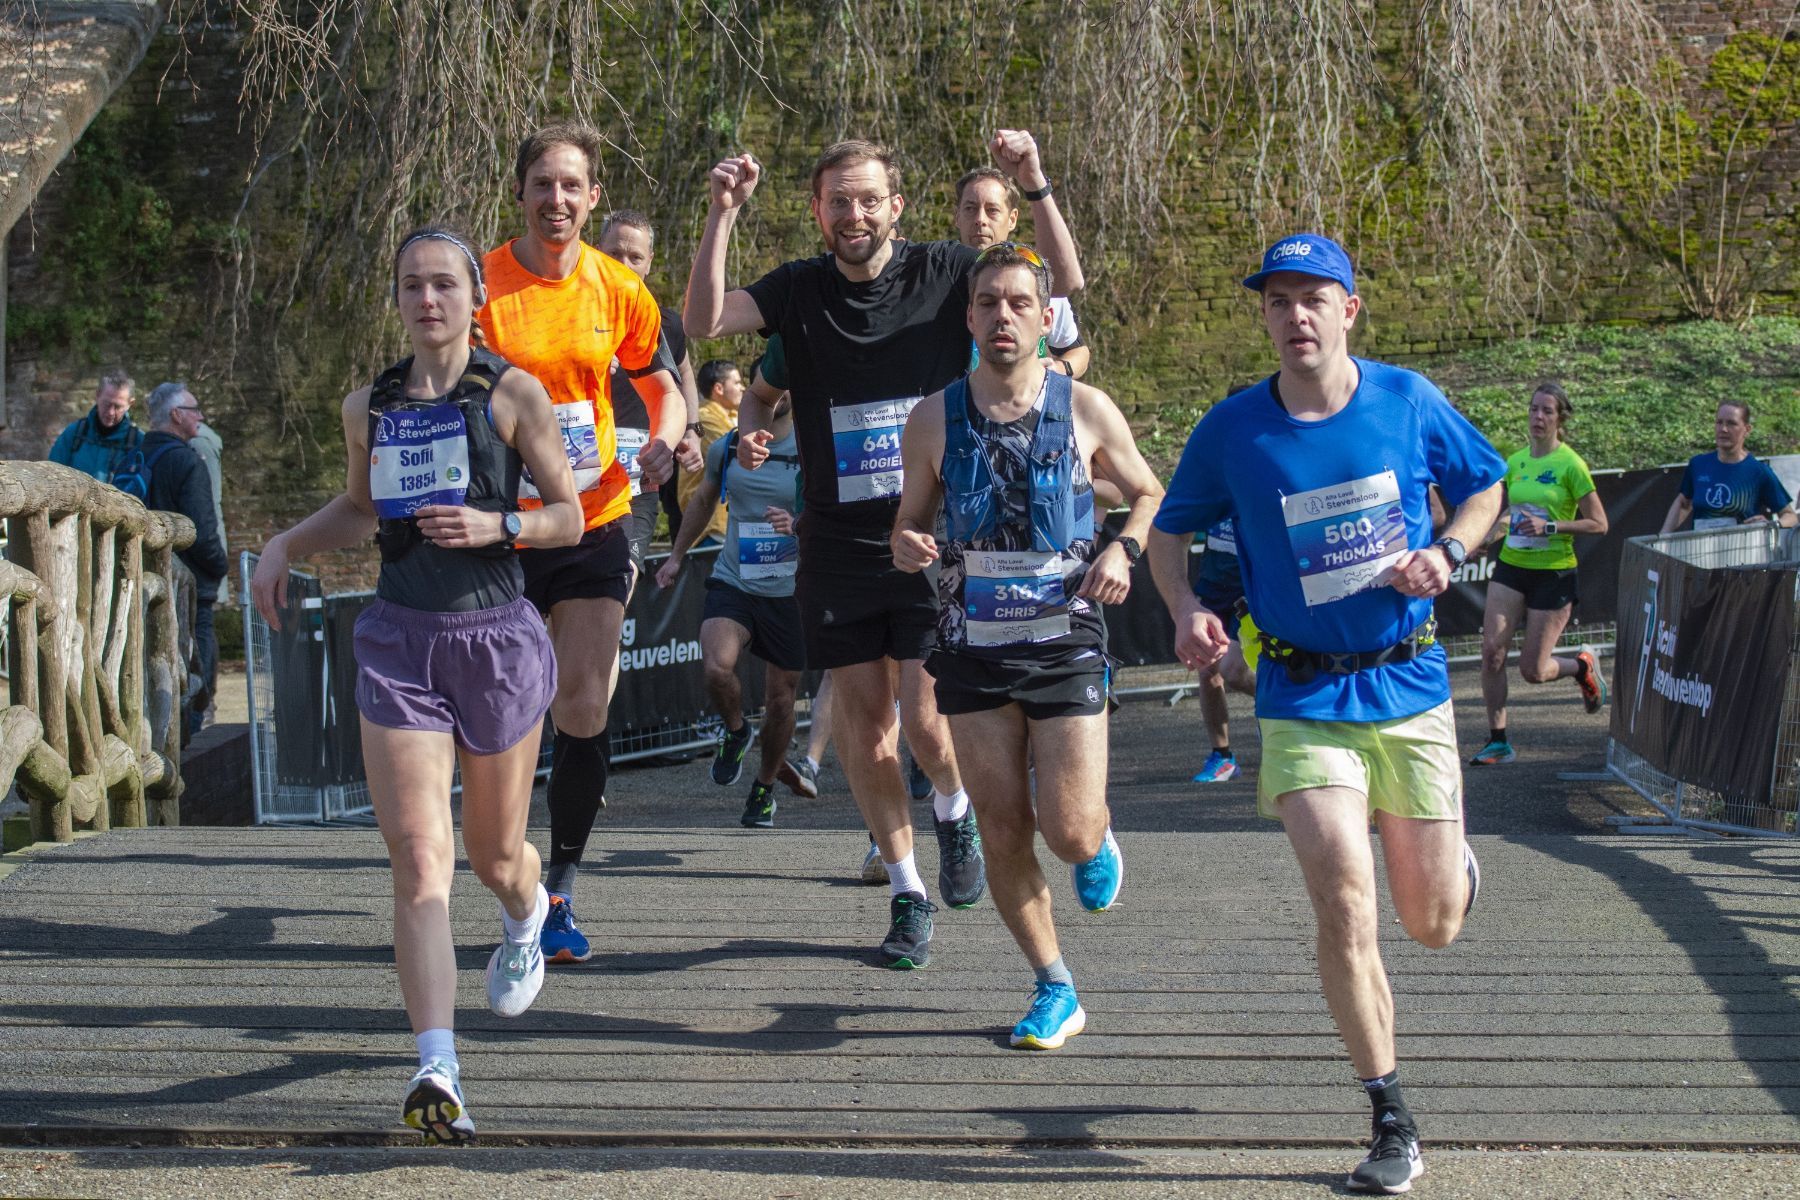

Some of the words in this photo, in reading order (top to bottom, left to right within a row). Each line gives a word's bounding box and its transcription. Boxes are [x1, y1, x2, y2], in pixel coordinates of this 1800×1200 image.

[399, 419, 415, 428] Alfa
[864, 412, 909, 423] Stevensloop
[863, 432, 900, 452] 641
[399, 469, 437, 492] 13854
[1326, 491, 1379, 510] Stevensloop
[1324, 516, 1373, 545] 500
[755, 541, 779, 552] 257
[1322, 540, 1386, 567] THOMAS
[759, 555, 777, 563] TOM
[998, 563, 1045, 572] Stevensloop
[994, 606, 1038, 618] CHRIS
[620, 618, 636, 647] g
